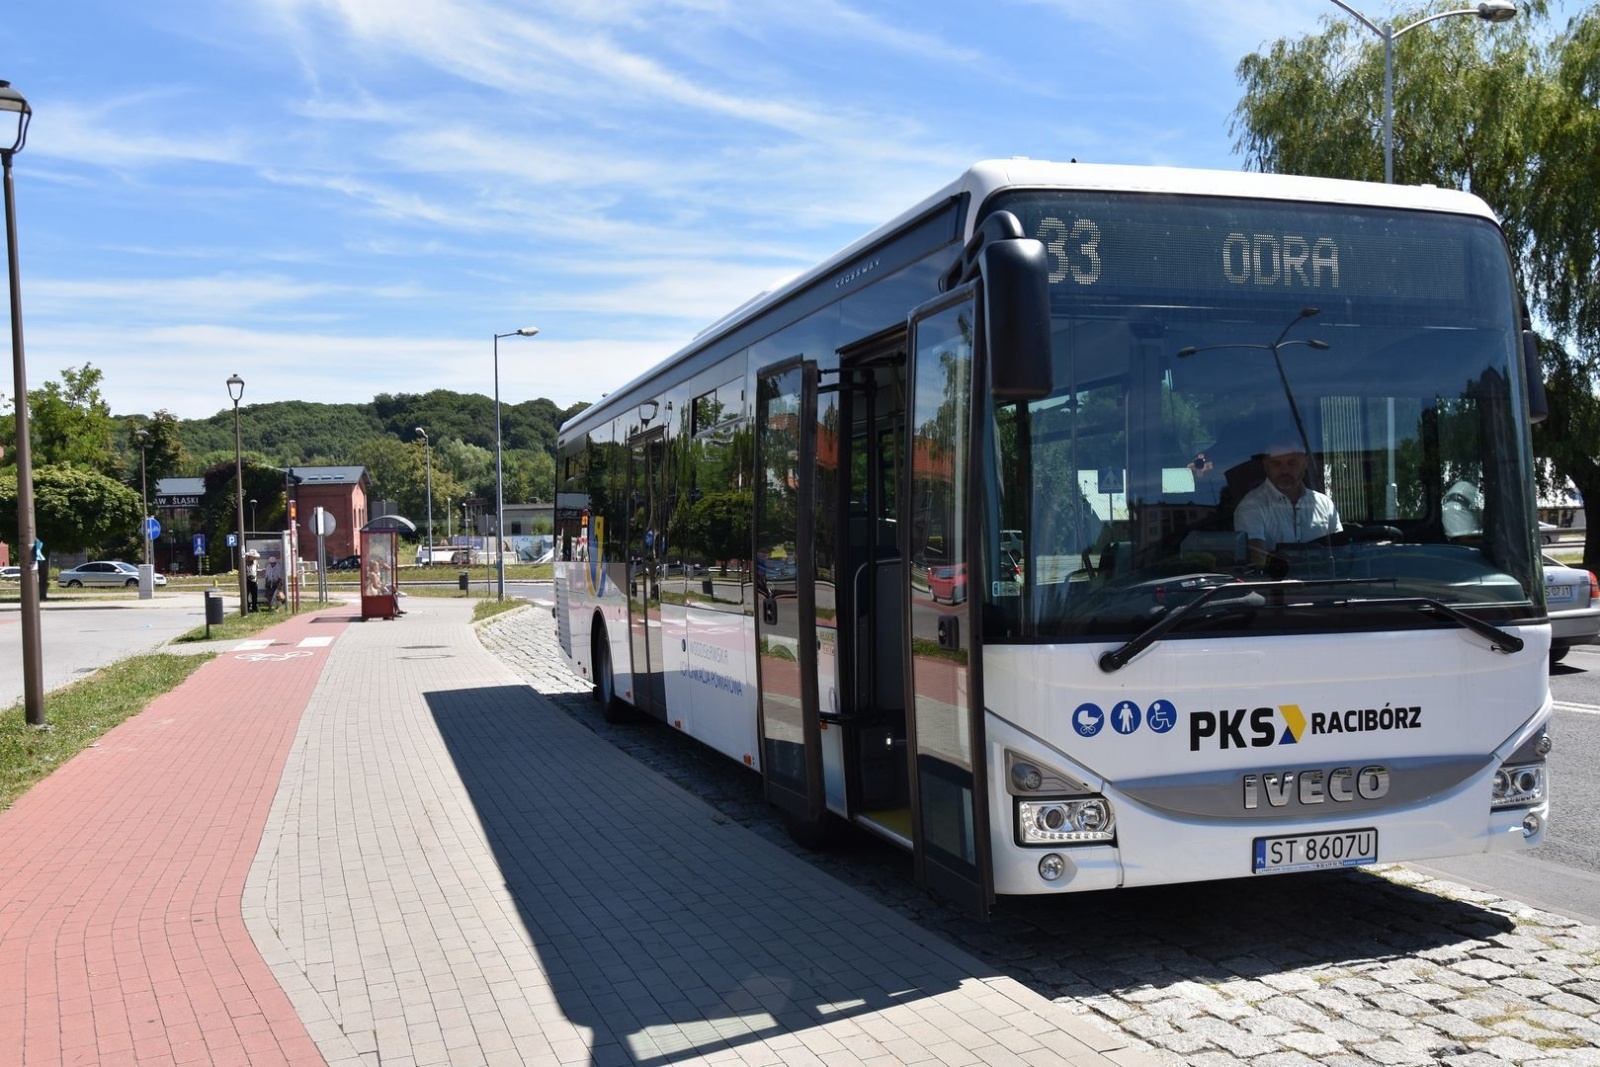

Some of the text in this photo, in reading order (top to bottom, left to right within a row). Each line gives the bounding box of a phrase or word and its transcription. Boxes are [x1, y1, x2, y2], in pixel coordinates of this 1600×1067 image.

[1036, 217, 1339, 288] 33 ODRA
[1189, 702, 1422, 752] PKS RACIBÓRZ
[1243, 765, 1391, 809] IVECO
[1270, 833, 1371, 864] ST 8607U
